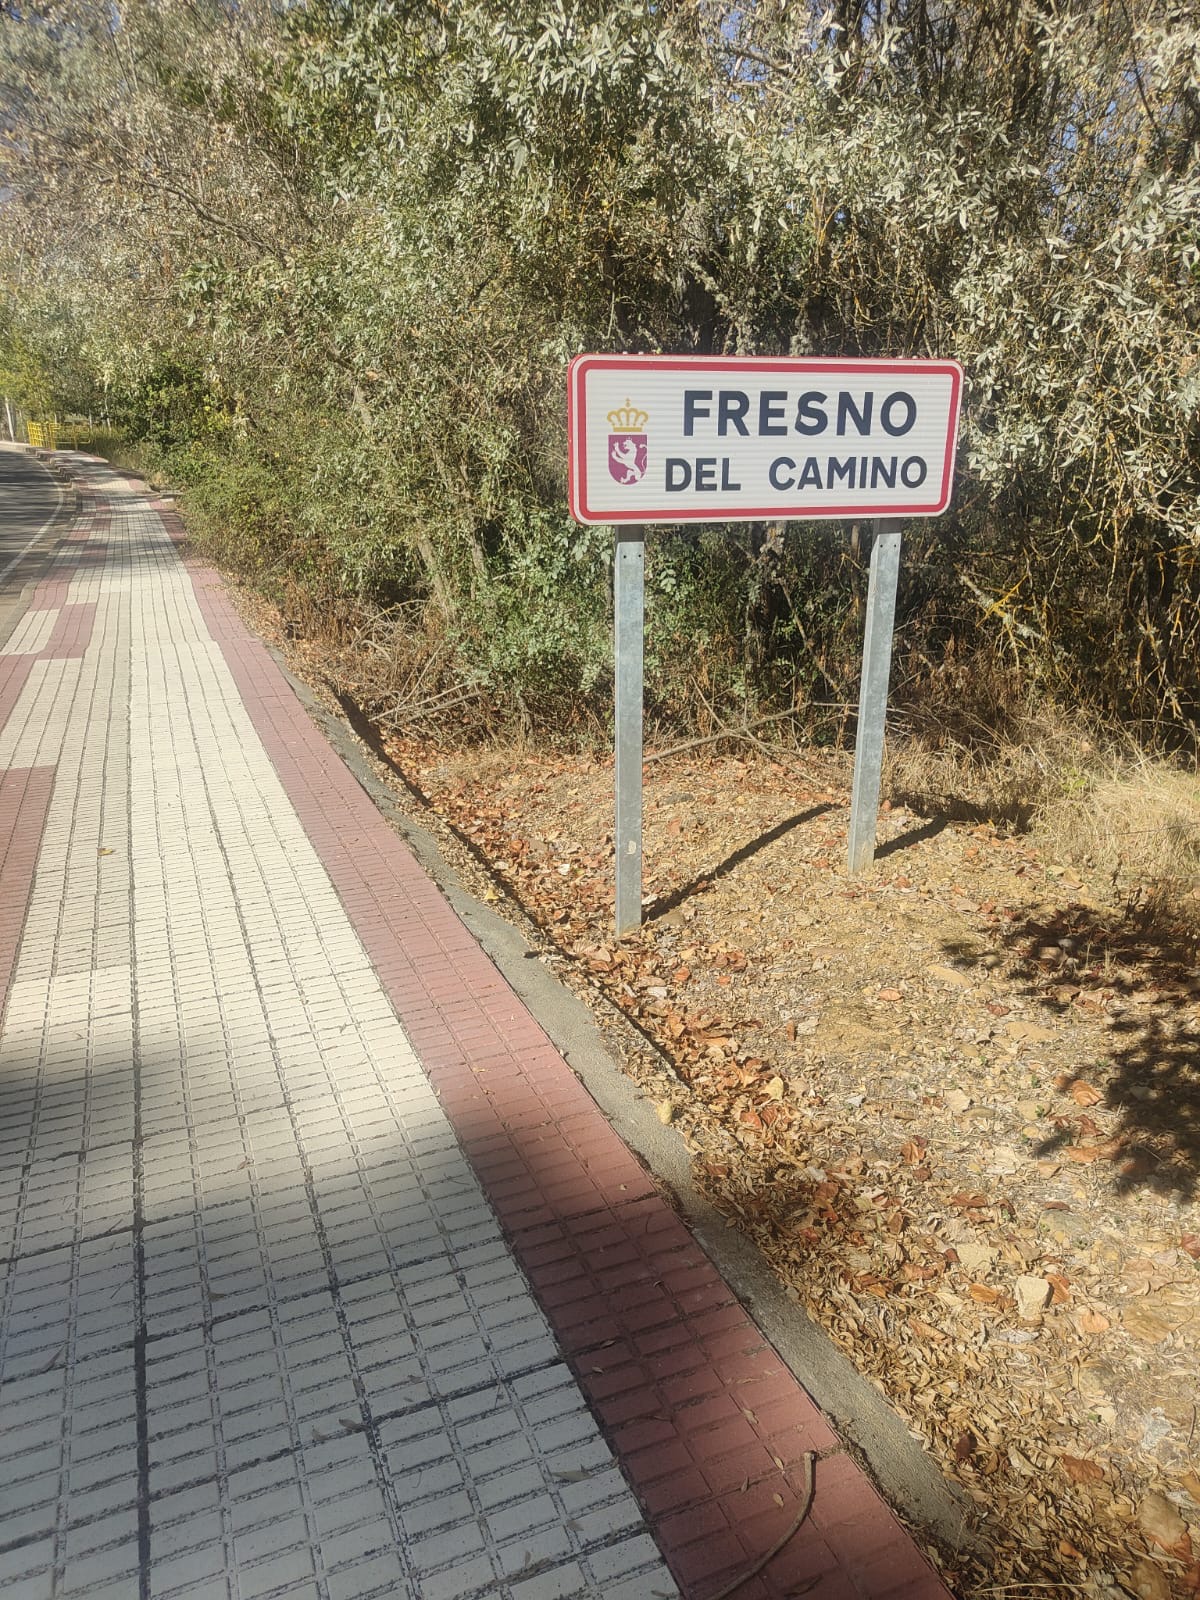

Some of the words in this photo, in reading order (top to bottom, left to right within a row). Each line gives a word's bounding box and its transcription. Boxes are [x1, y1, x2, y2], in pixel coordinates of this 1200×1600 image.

[683, 390, 917, 437] FRESNO
[665, 457, 741, 492] DEL
[768, 455, 927, 491] CAMINO
